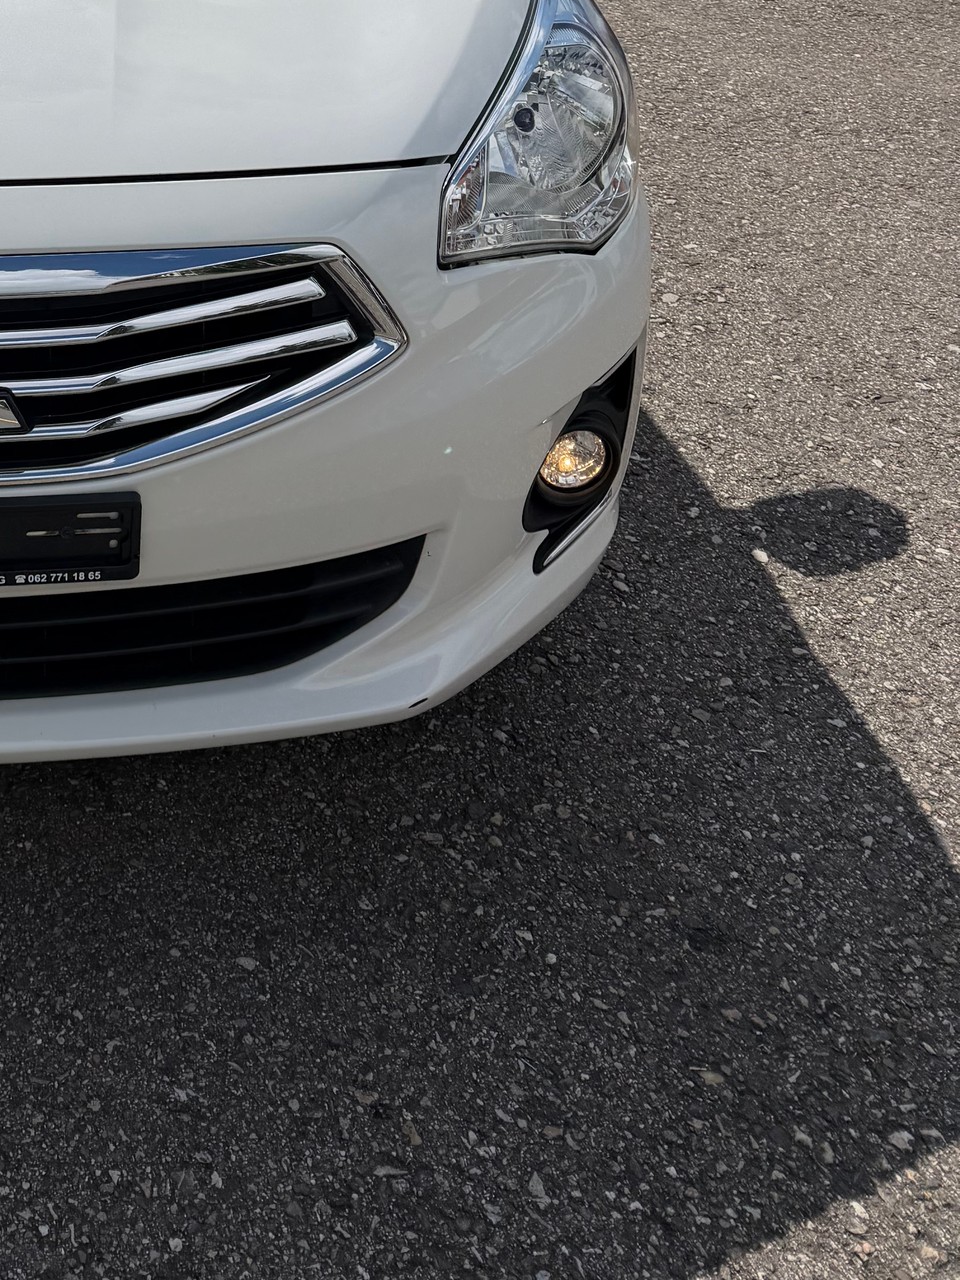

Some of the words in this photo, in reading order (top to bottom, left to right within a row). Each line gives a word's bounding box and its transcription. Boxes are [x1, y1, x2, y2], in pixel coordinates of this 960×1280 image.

[28, 574, 47, 583] 062
[50, 573, 68, 582] 771
[72, 571, 85, 581] 18
[88, 571, 101, 580] 65
